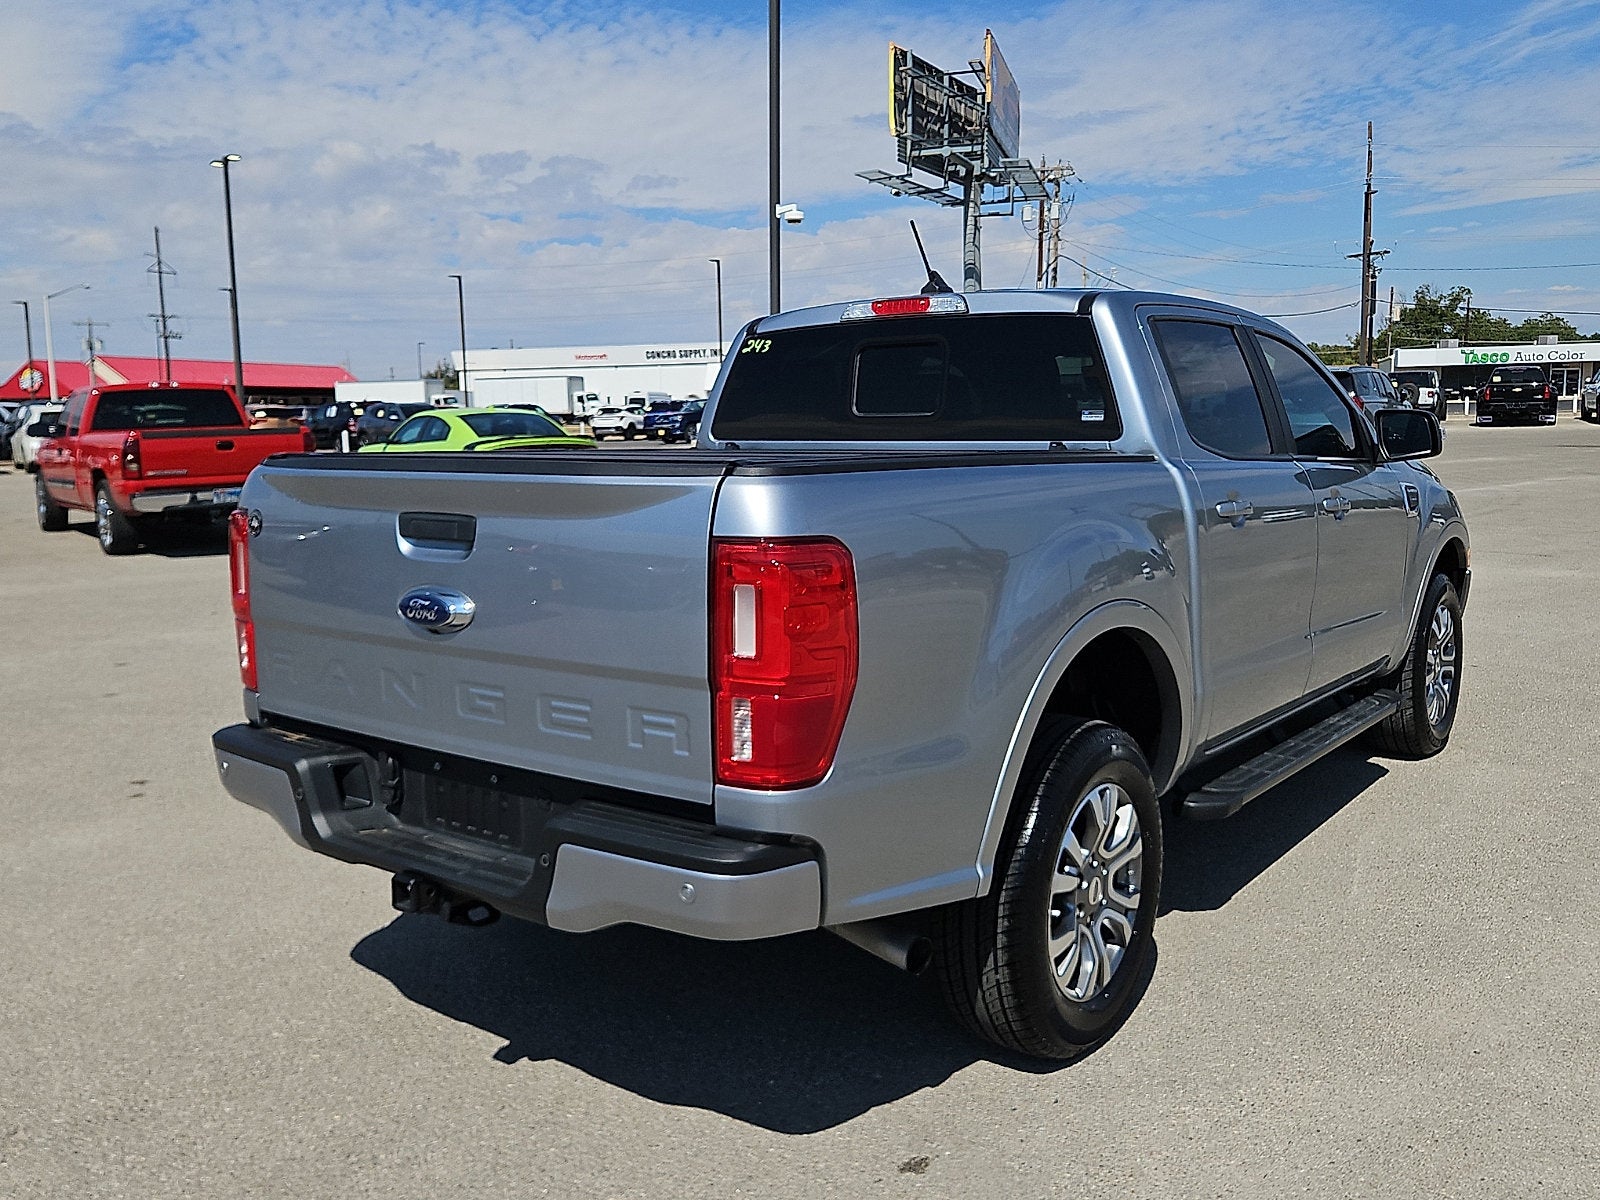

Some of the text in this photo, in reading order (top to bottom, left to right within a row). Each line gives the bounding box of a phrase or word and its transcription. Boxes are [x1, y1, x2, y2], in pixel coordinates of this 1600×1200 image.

[741, 339, 772, 354] 243
[646, 350, 677, 360] CONCHO
[1461, 349, 1586, 364] TASCO Auto Color
[405, 597, 438, 621] Ford
[268, 650, 691, 757] RANGER
